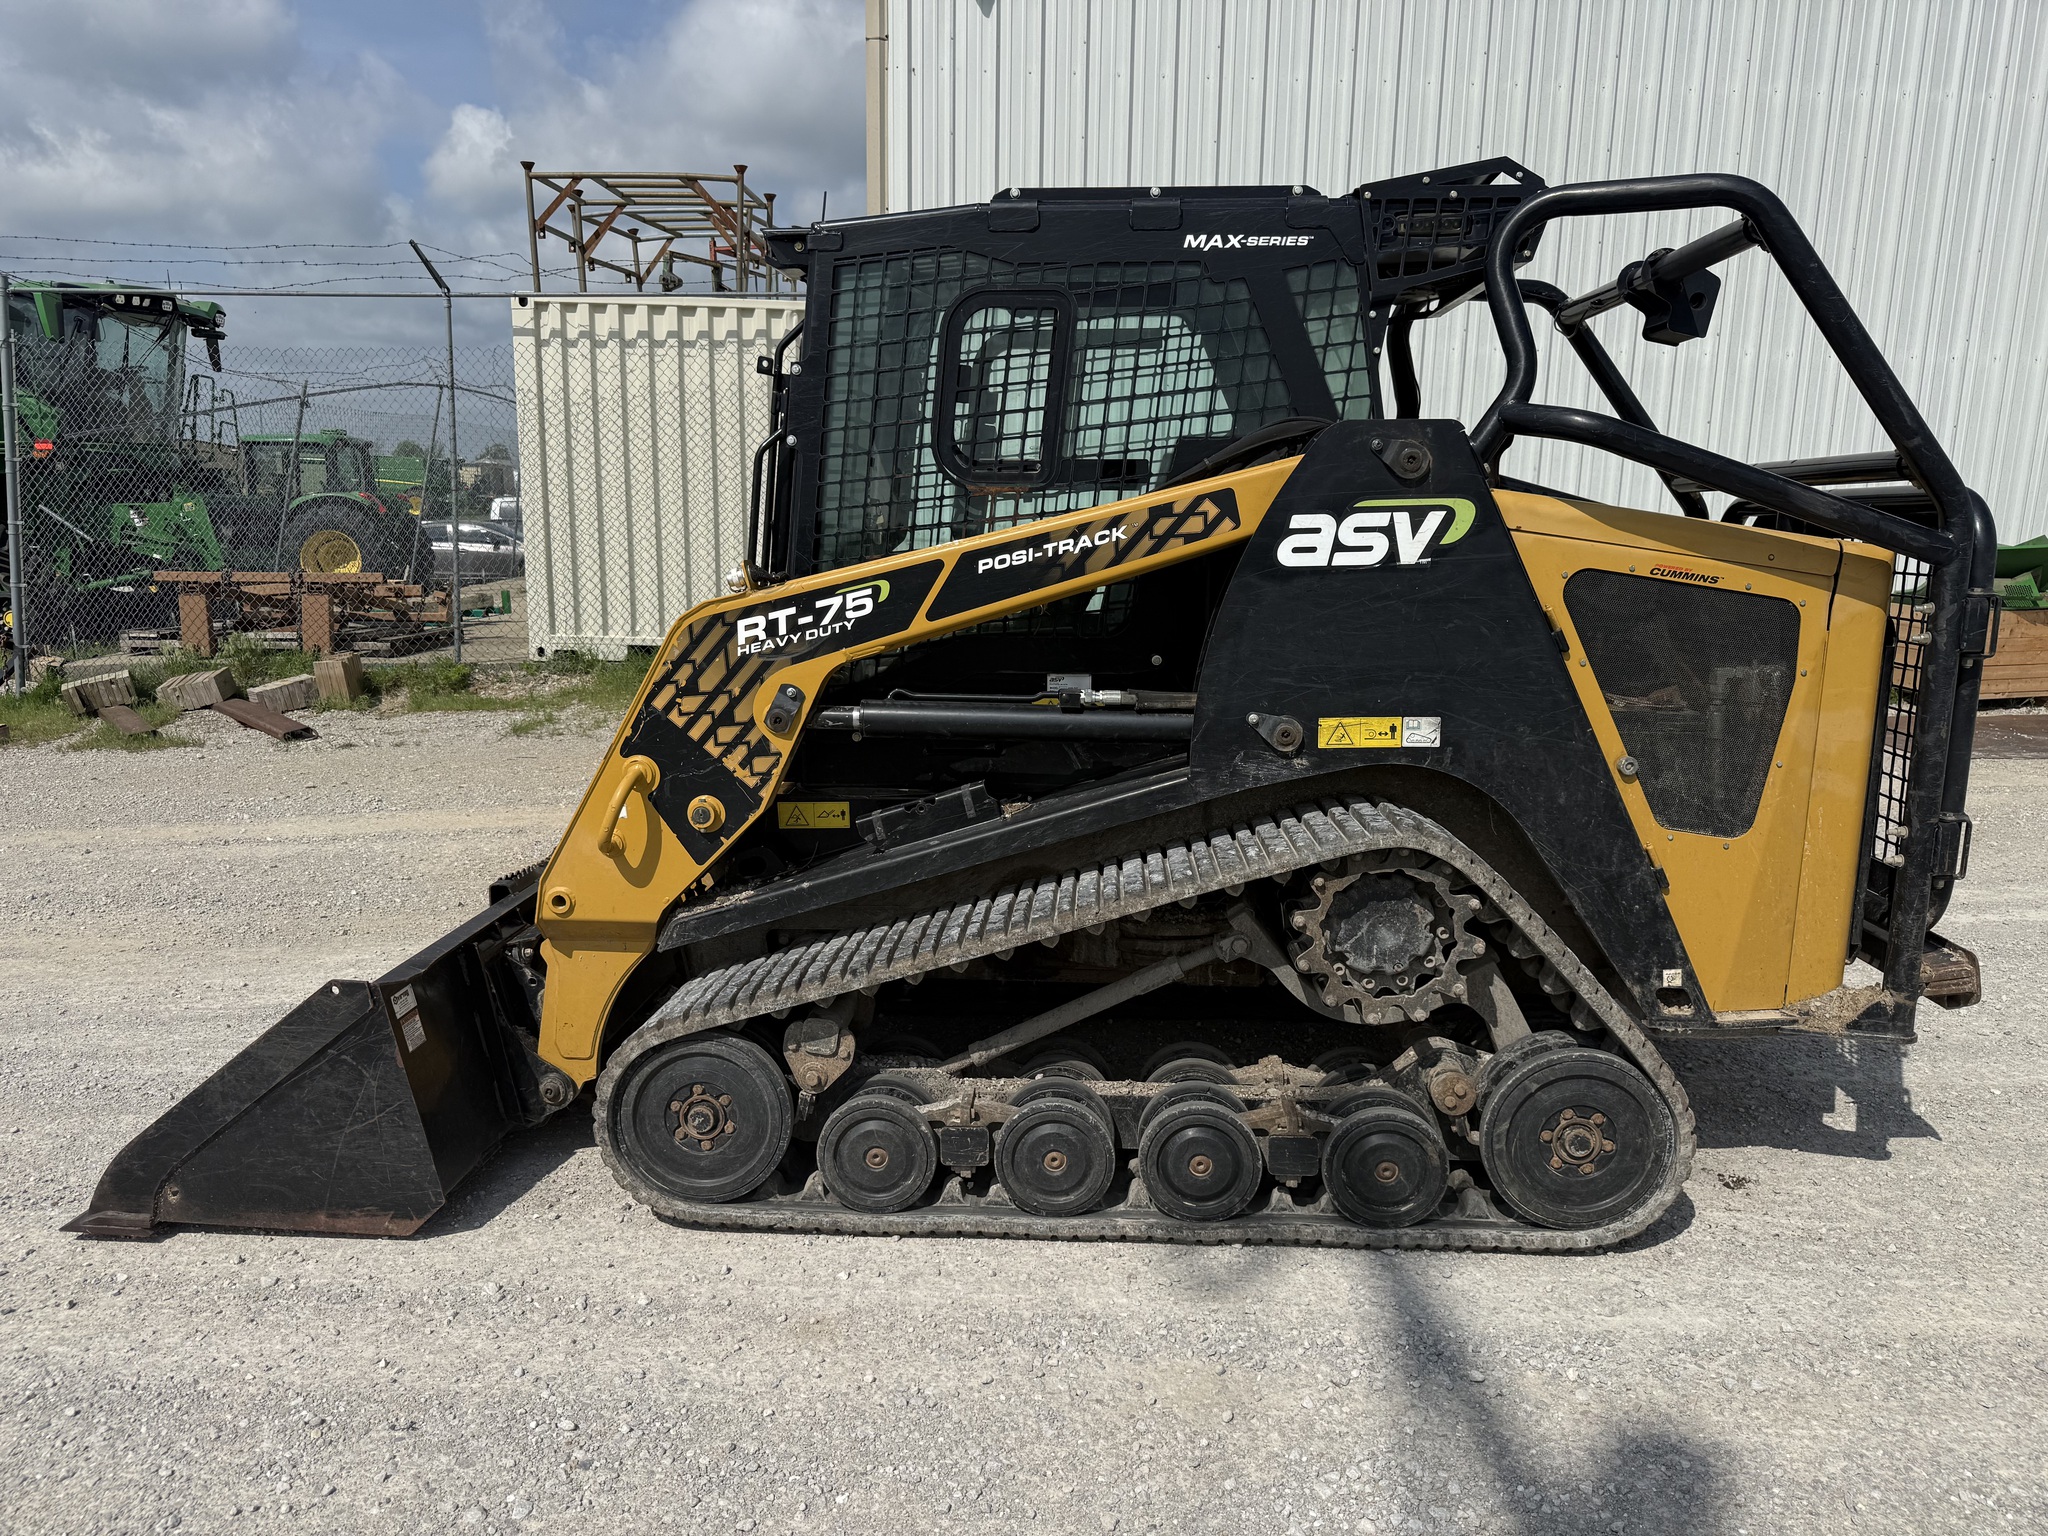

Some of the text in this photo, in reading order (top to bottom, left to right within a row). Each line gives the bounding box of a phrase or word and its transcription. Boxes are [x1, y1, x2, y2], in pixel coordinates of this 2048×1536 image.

[1649, 567, 1720, 584] CUMMINS
[1654, 563, 1684, 571] POWERED
[736, 587, 874, 646] RT-75
[737, 618, 856, 657] HEAVY DUTY
